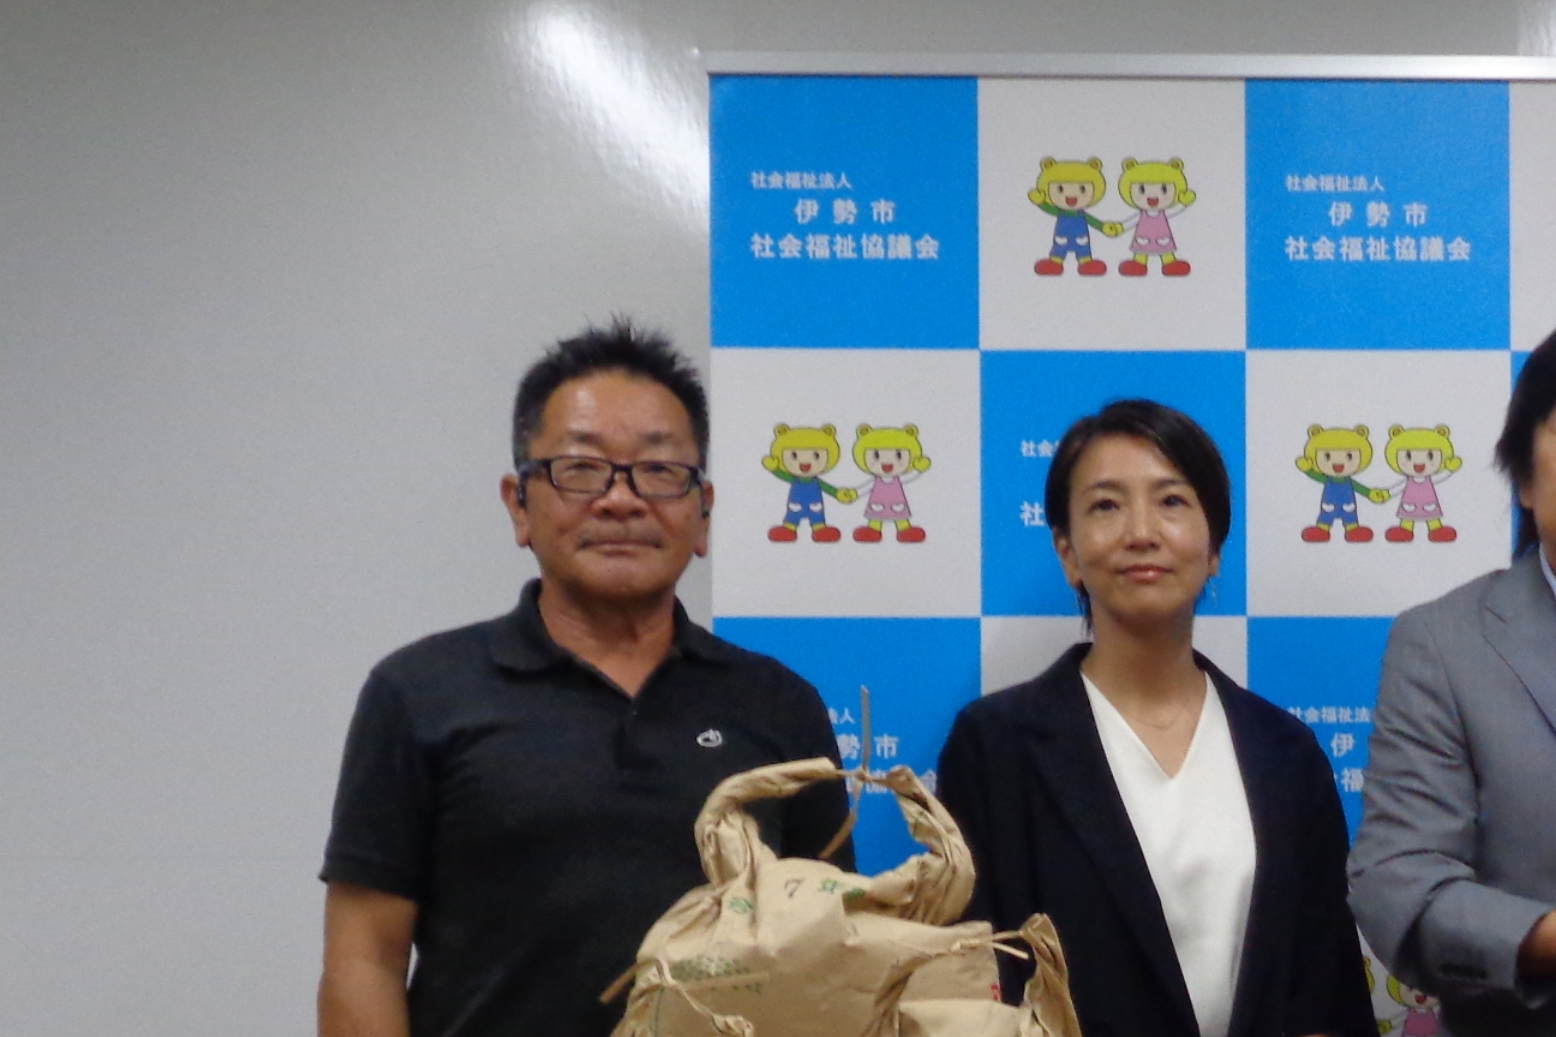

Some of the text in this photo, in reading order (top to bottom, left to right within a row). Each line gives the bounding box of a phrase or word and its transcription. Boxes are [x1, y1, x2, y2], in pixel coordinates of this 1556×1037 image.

[750, 171, 853, 190] 社会福祉法人
[1285, 174, 1386, 193] 社会福祉法人
[793, 198, 897, 225] 伊勢市
[1328, 200, 1429, 228] 伊勢市
[750, 232, 940, 260] 社会福祉協議会
[1284, 235, 1471, 262] 社会福祉協議会
[1287, 706, 1372, 723] 社会福祉法
[837, 734, 899, 759] 勢市
